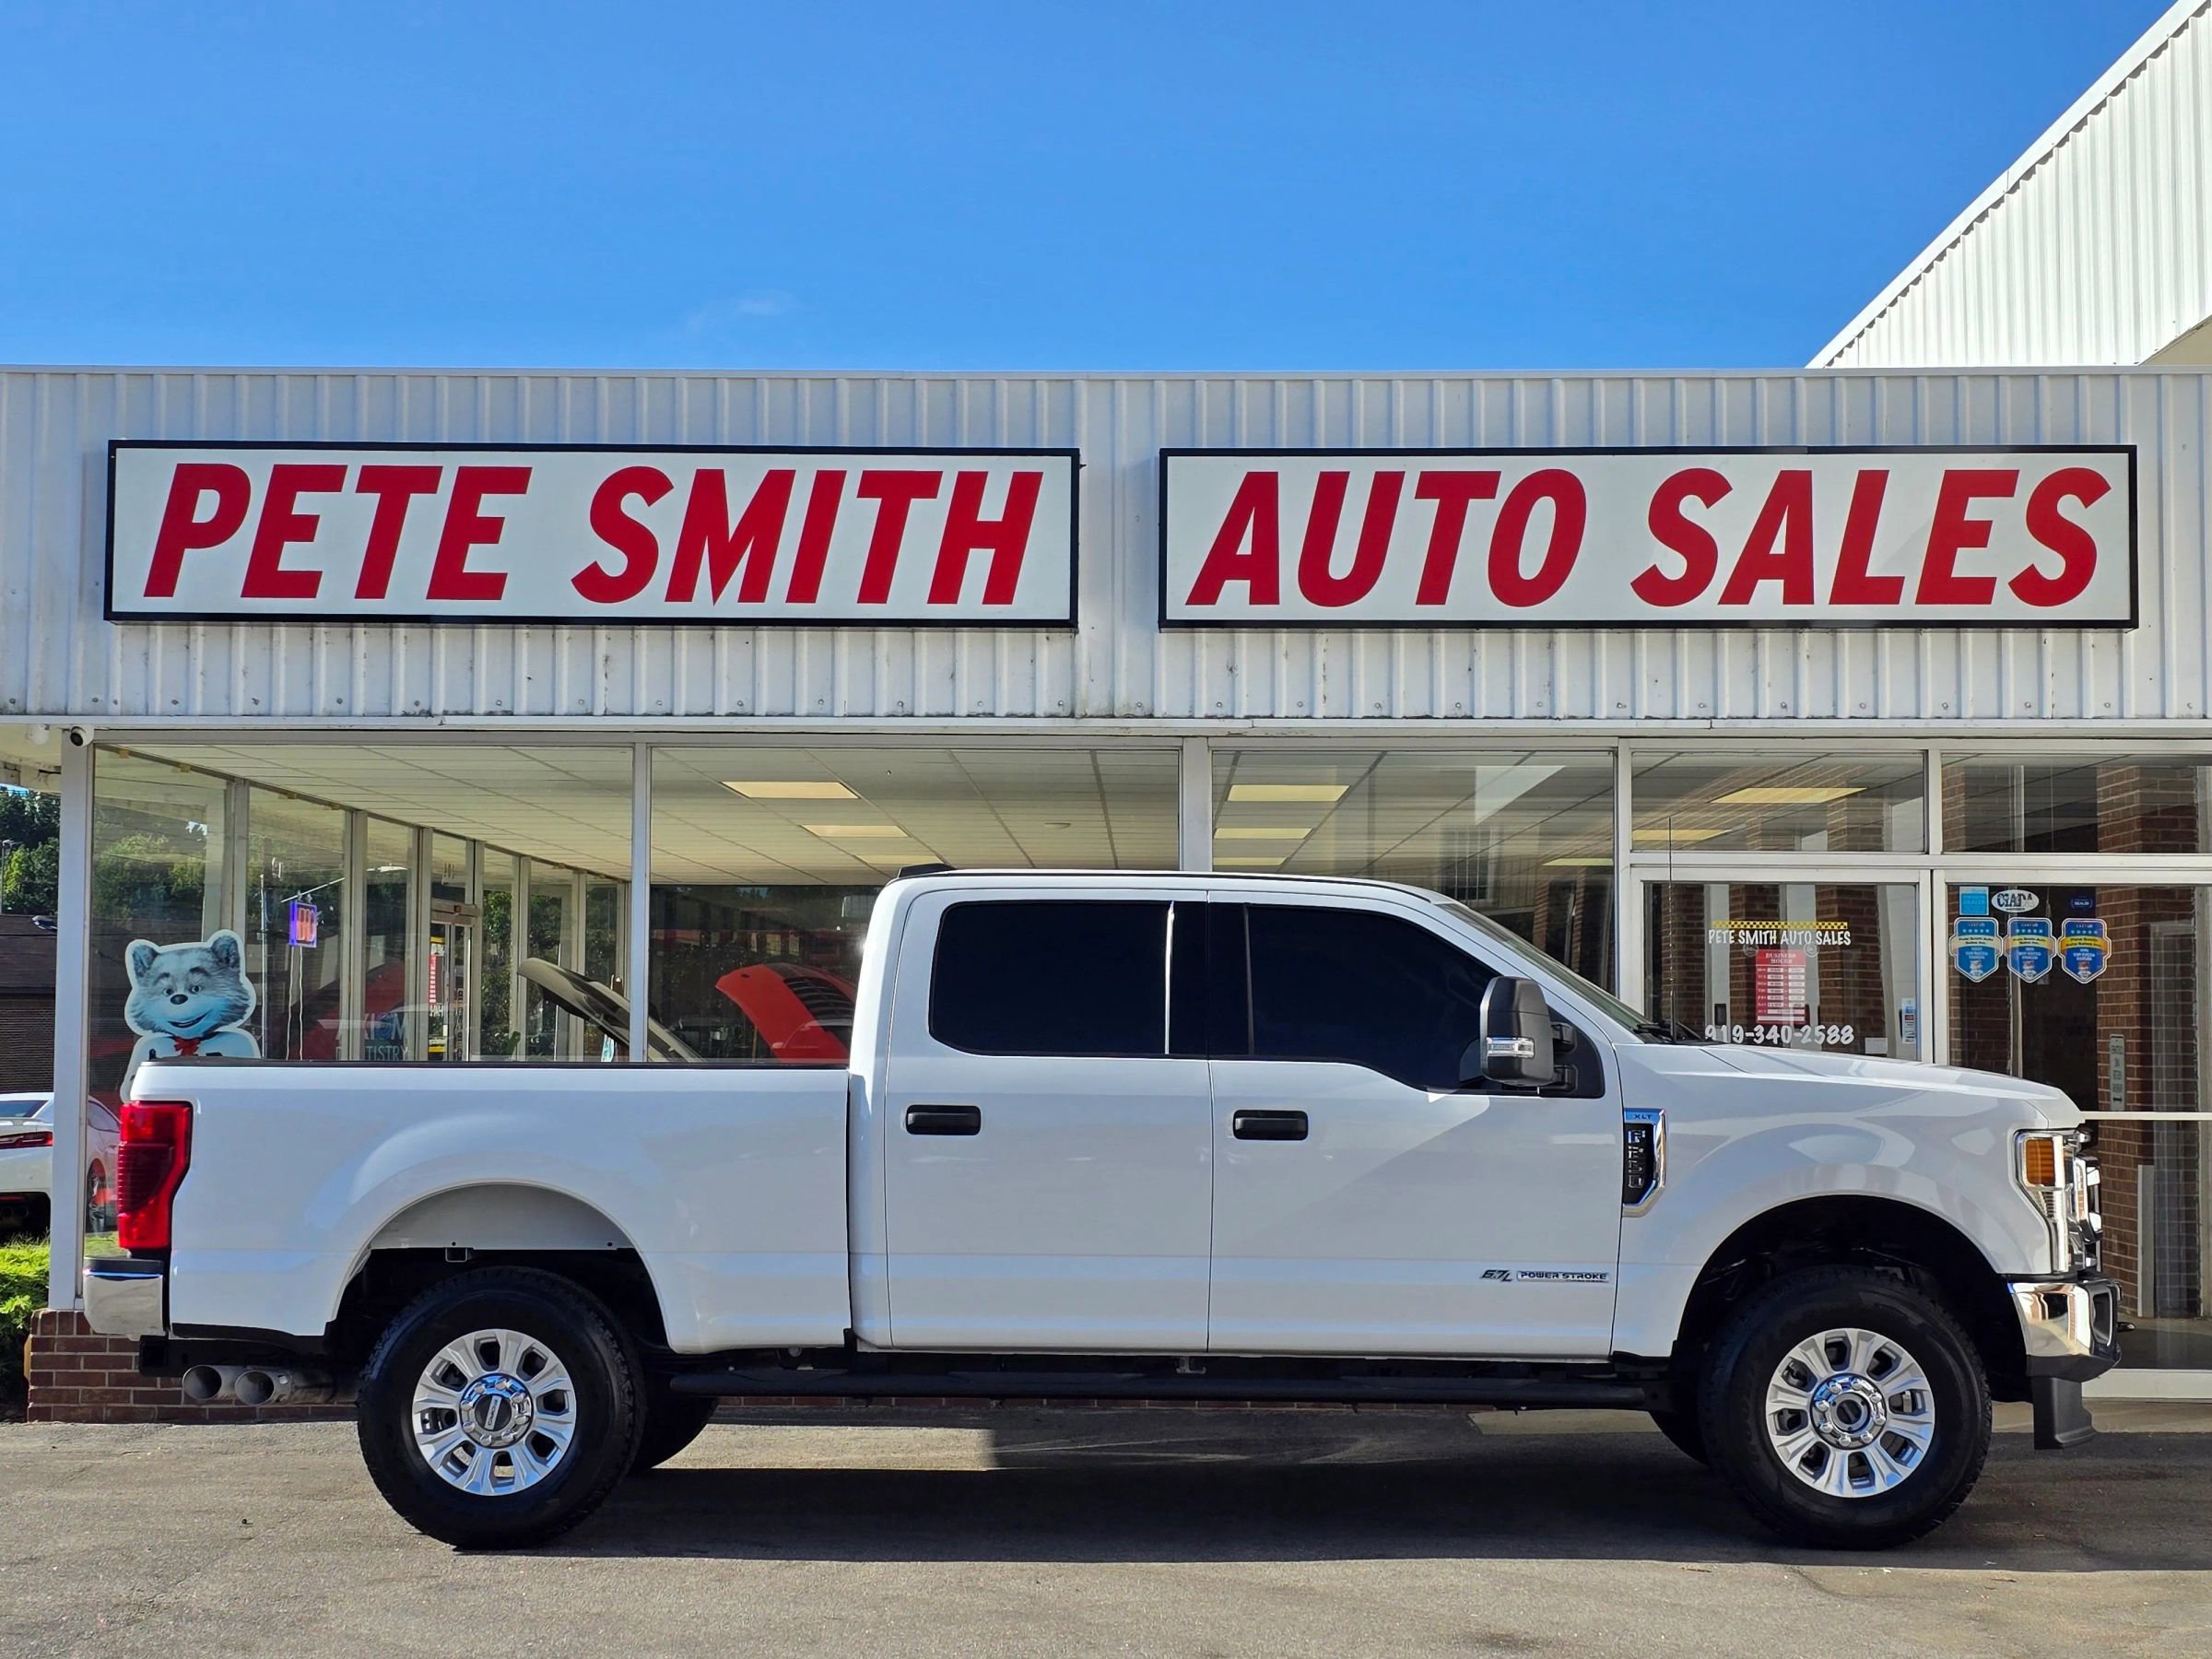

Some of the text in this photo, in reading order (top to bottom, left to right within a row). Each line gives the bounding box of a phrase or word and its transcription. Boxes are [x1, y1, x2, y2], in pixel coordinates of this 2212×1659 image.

[144, 464, 1044, 606] PETE SMITH
[1186, 467, 2112, 608] AUTO SALES
[1708, 929, 1852, 946] PETE SMITH AUTO SALES
[1705, 1024, 1855, 1045] 919-340-2588
[1520, 1271, 1559, 1279] POWER
[1561, 1272, 1607, 1280] STROKE
